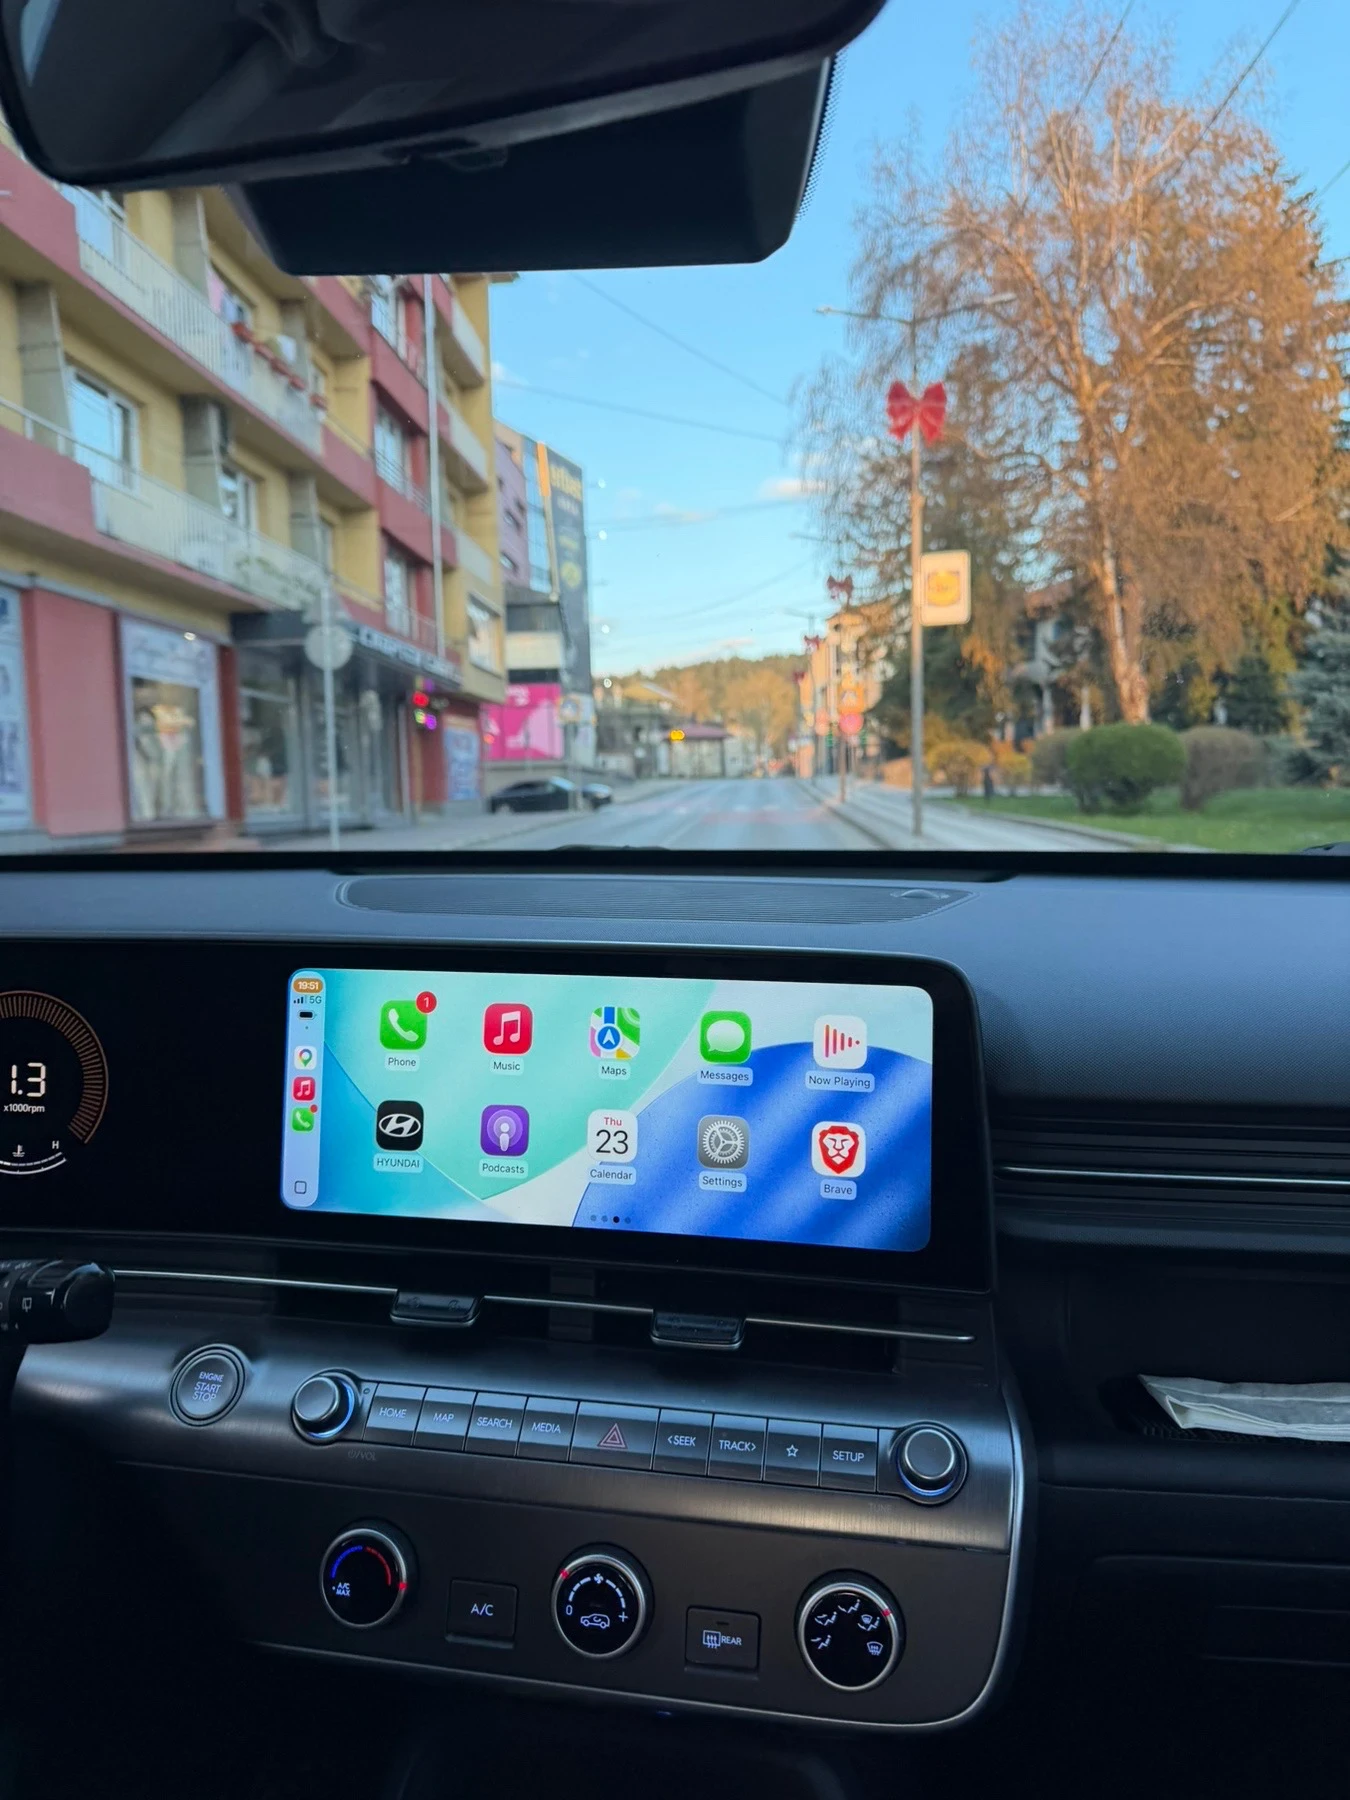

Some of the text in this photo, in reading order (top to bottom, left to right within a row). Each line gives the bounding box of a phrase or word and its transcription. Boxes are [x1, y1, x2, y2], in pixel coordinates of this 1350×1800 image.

[298, 981, 319, 990] 19:51
[309, 995, 322, 1004] 5G
[424, 997, 430, 1008] 1
[388, 1057, 417, 1067] Phone
[493, 1061, 521, 1071] Music
[601, 1066, 627, 1076] Maps
[700, 1070, 749, 1082] Messages
[11, 1062, 46, 1097] 1.3
[809, 1075, 871, 1089] Now Playing
[3, 1103, 45, 1114] x1000rpm
[604, 1117, 622, 1127] Thu
[51, 1140, 60, 1150] H
[595, 1129, 629, 1155] 23
[376, 1158, 420, 1168] HYUNDAI
[482, 1163, 525, 1174] Podcasts
[590, 1169, 633, 1180] Calendar
[702, 1176, 743, 1188] Settings
[823, 1184, 853, 1195] Brave
[199, 1371, 225, 1382] ENGINE
[194, 1381, 222, 1394] START
[192, 1391, 217, 1402] STOP
[379, 1407, 408, 1419] HOME
[433, 1412, 455, 1423] MAP
[476, 1416, 513, 1429] SEARCH
[531, 1422, 562, 1434] MEDIA
[832, 1450, 865, 1463] SETUP
[335, 1589, 351, 1597] MAX
[470, 1603, 494, 1617] A/C
[720, 1634, 743, 1646] REAR
